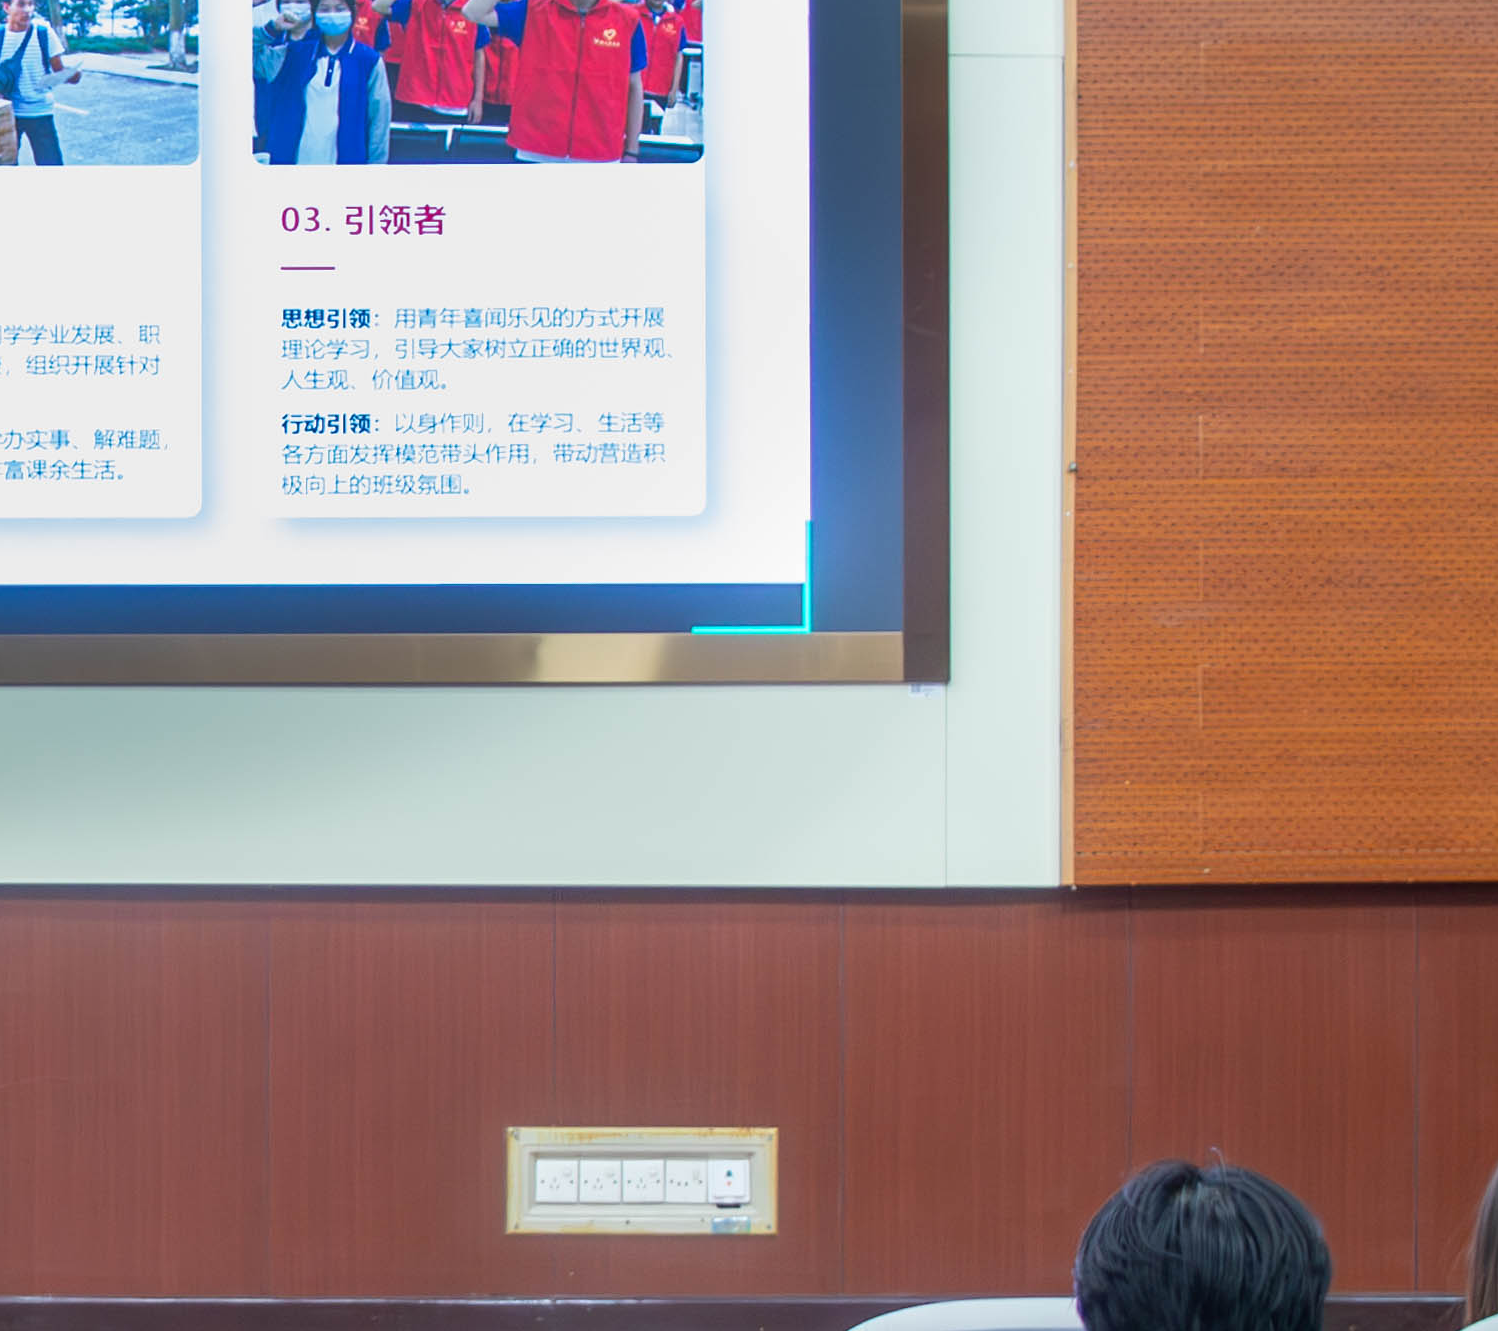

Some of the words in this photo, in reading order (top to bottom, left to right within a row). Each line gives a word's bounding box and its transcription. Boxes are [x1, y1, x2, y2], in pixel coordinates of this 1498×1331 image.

[281, 207, 330, 232] 03.
[345, 204, 446, 235] 引领者
